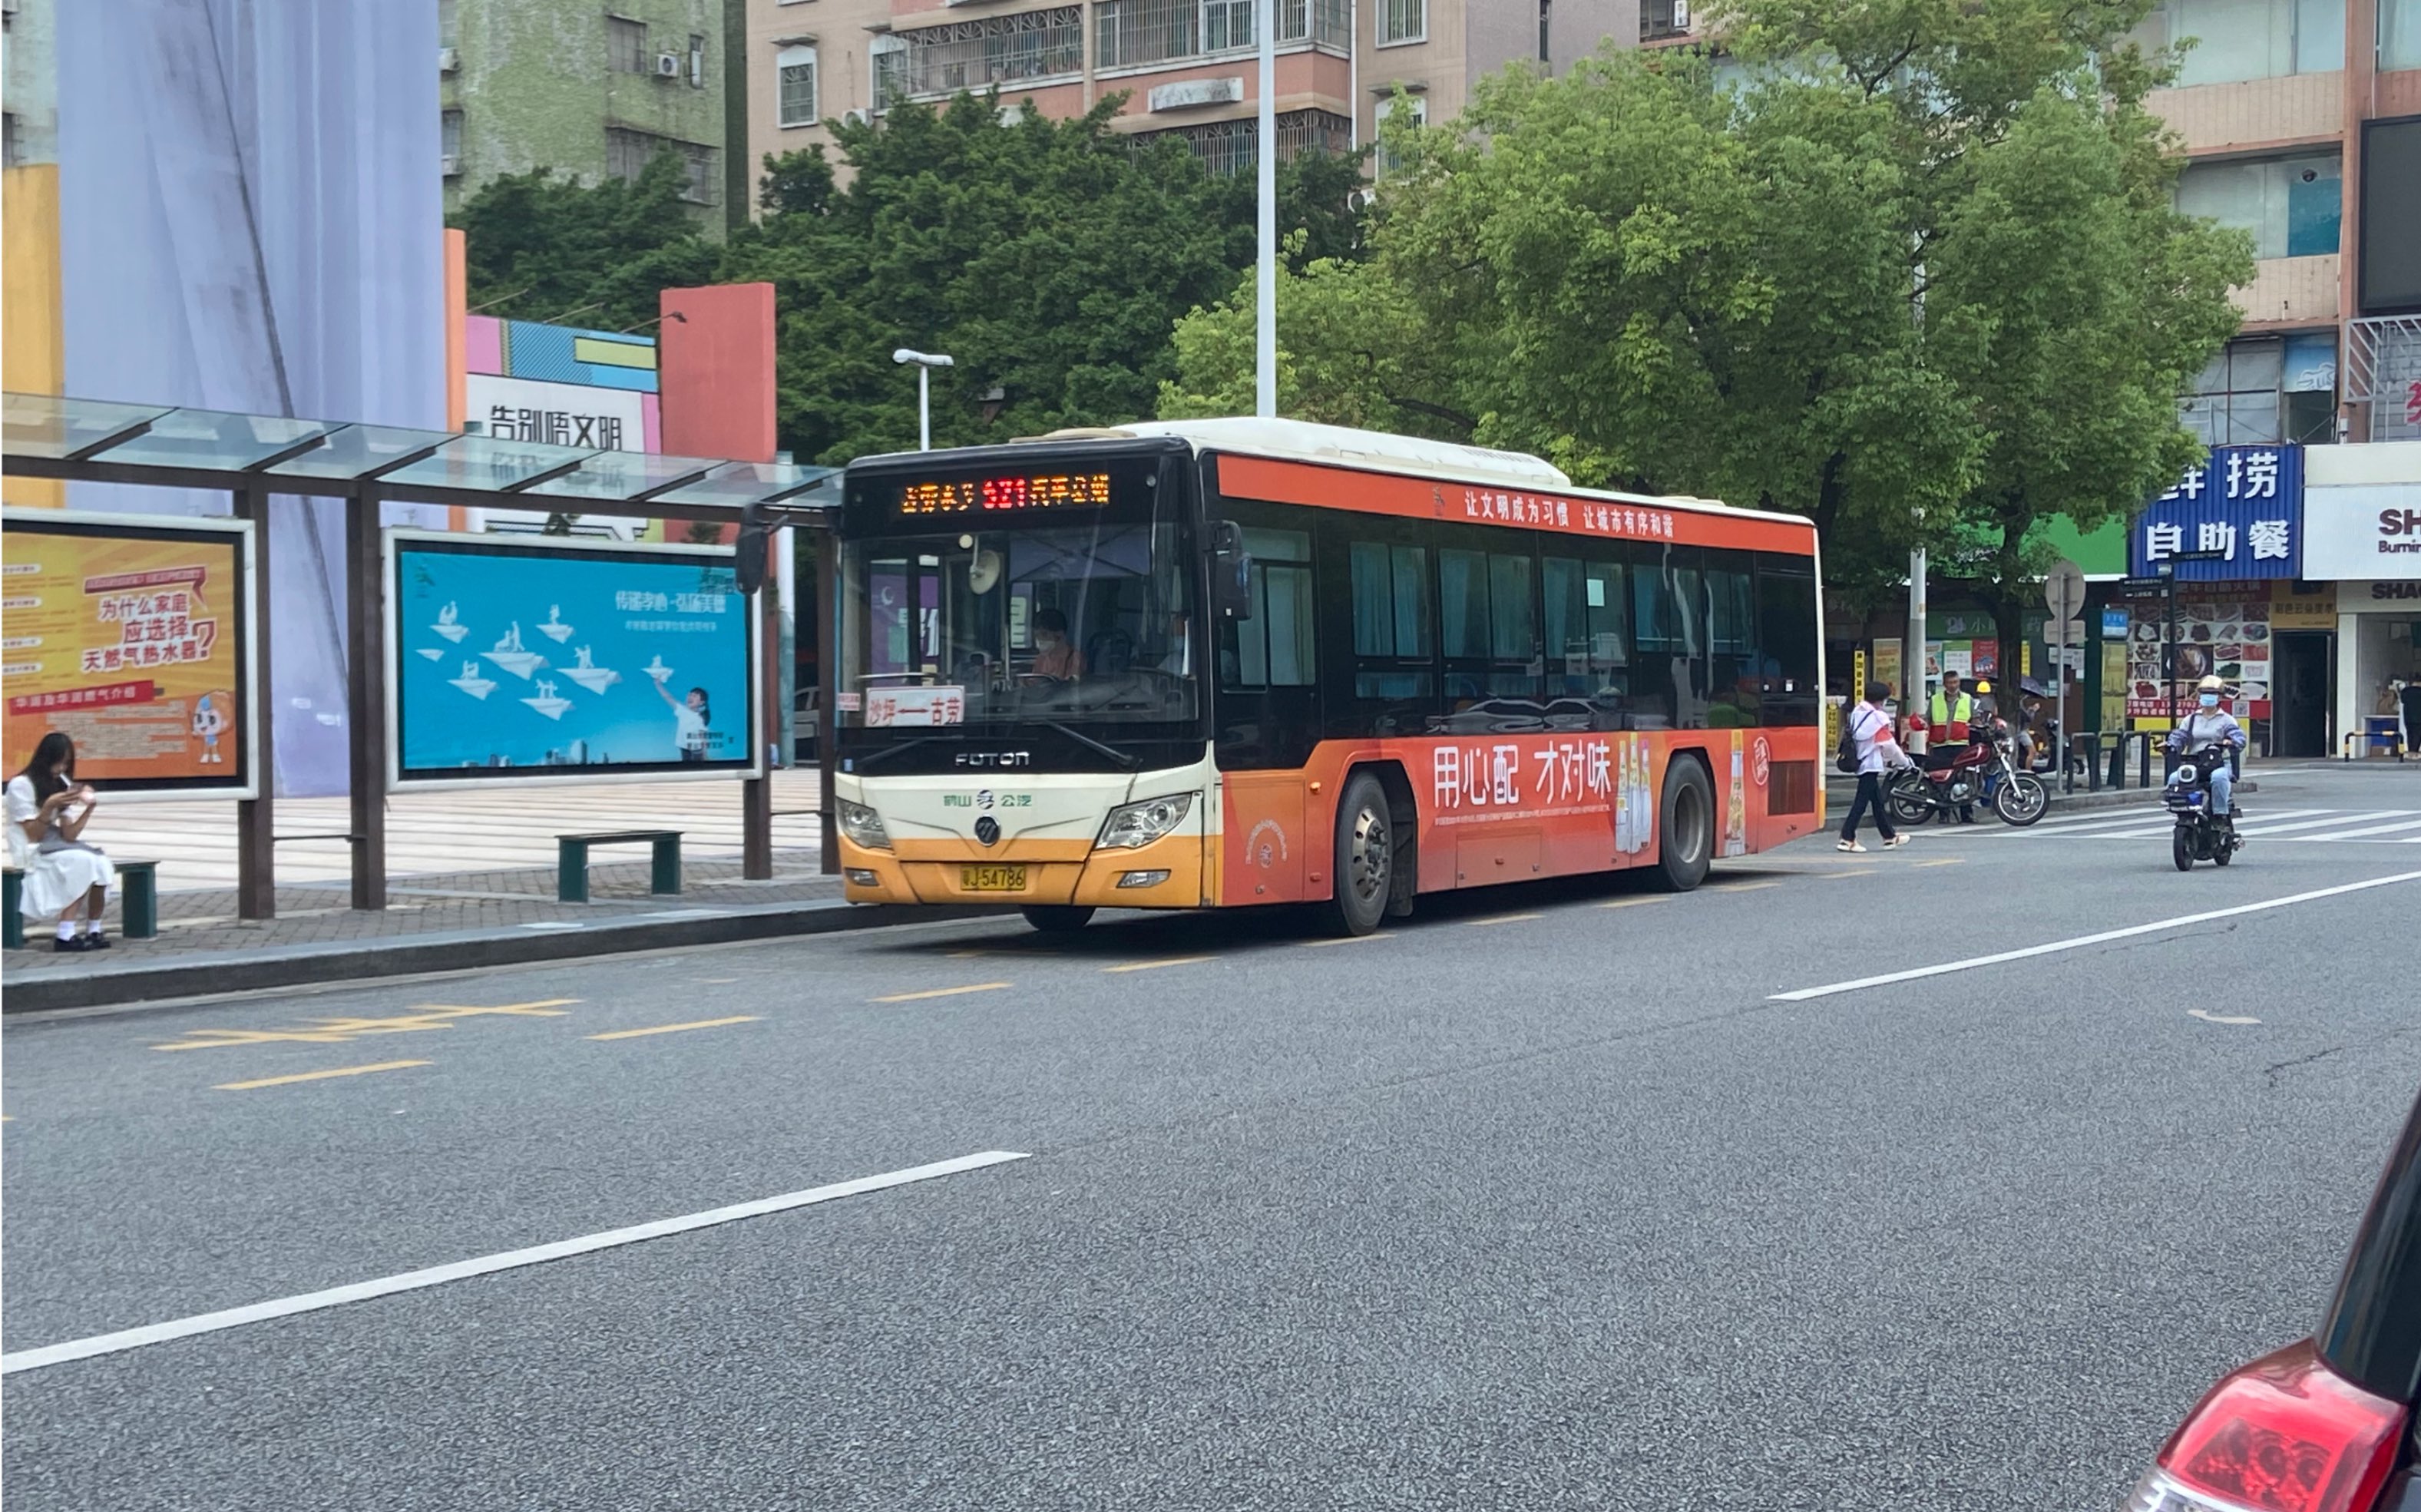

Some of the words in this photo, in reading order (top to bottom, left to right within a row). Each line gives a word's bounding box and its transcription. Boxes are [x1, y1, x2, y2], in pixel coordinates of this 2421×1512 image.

[490, 405, 623, 452] 告别唔文明
[1464, 490, 1569, 528] 让文明成为习惯
[1583, 505, 1674, 538] 让城市有序和谐
[2146, 519, 2289, 562] 自助餐
[101, 593, 187, 620] 为什么家庭
[124, 615, 189, 644] 应选择
[931, 696, 961, 726] 古劳
[955, 752, 1029, 766] FOTON
[1434, 744, 1520, 809] 用心配
[1534, 739, 1612, 805] 才对味
[1000, 794, 1032, 807] 公汽
